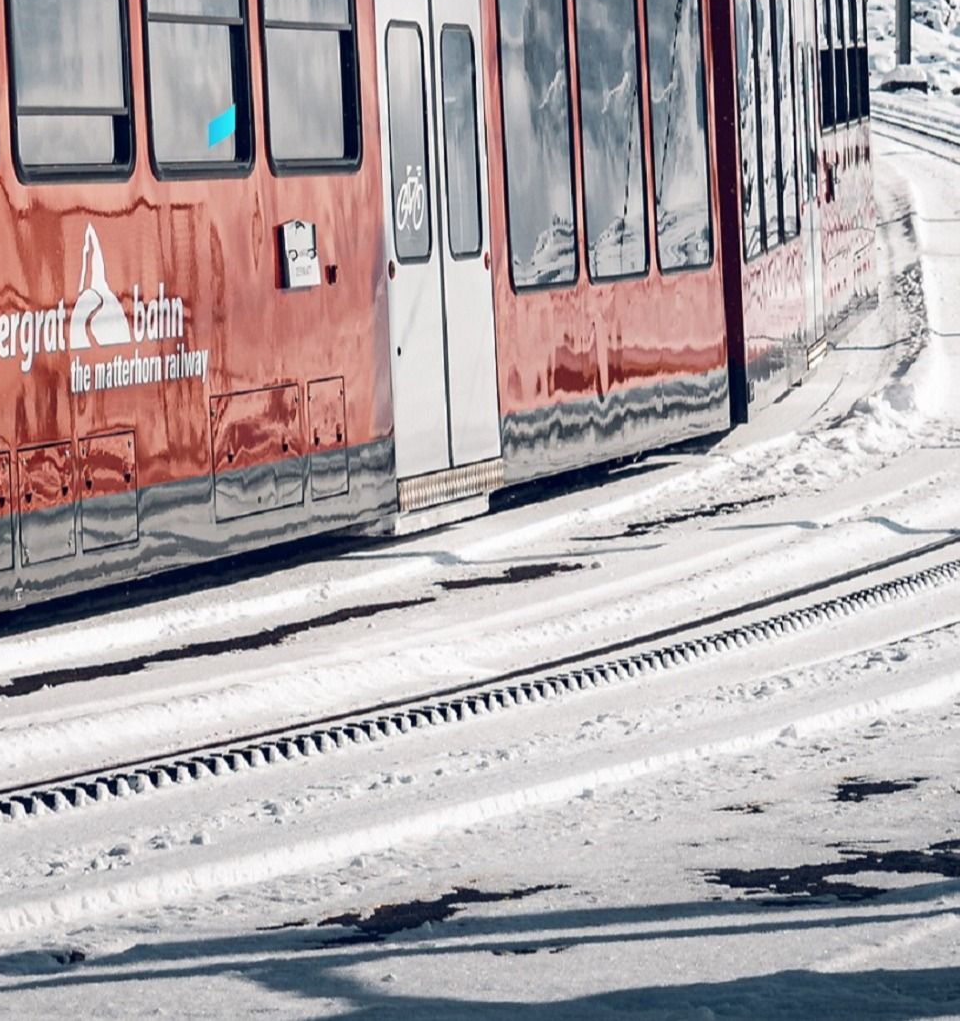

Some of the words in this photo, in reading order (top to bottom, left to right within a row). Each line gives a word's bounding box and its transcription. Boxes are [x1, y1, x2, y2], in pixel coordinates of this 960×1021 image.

[132, 282, 184, 342] bahn
[70, 355, 91, 393] the
[94, 349, 163, 388] matterhorn
[164, 342, 209, 383] railway
